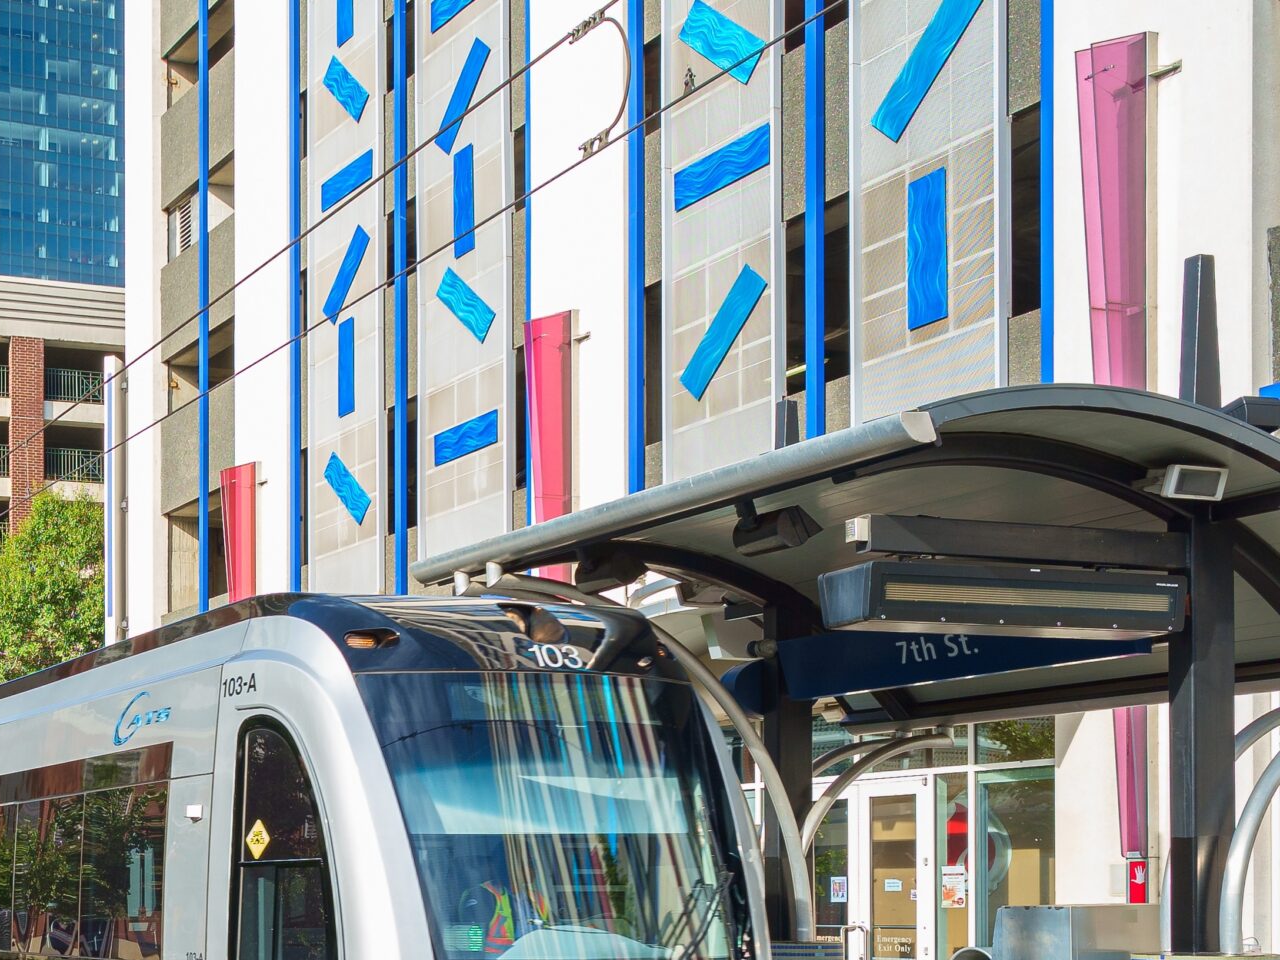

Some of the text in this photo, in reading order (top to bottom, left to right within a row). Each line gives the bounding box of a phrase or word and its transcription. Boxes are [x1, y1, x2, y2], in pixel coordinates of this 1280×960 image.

[527, 644, 583, 669] 103
[895, 634, 979, 664] 7th St.
[222, 672, 257, 698] 103-A
[113, 691, 172, 746] CATS
[816, 935, 842, 944] mergenc
[876, 935, 913, 945] Emergency
[878, 944, 912, 953] Exit Only
